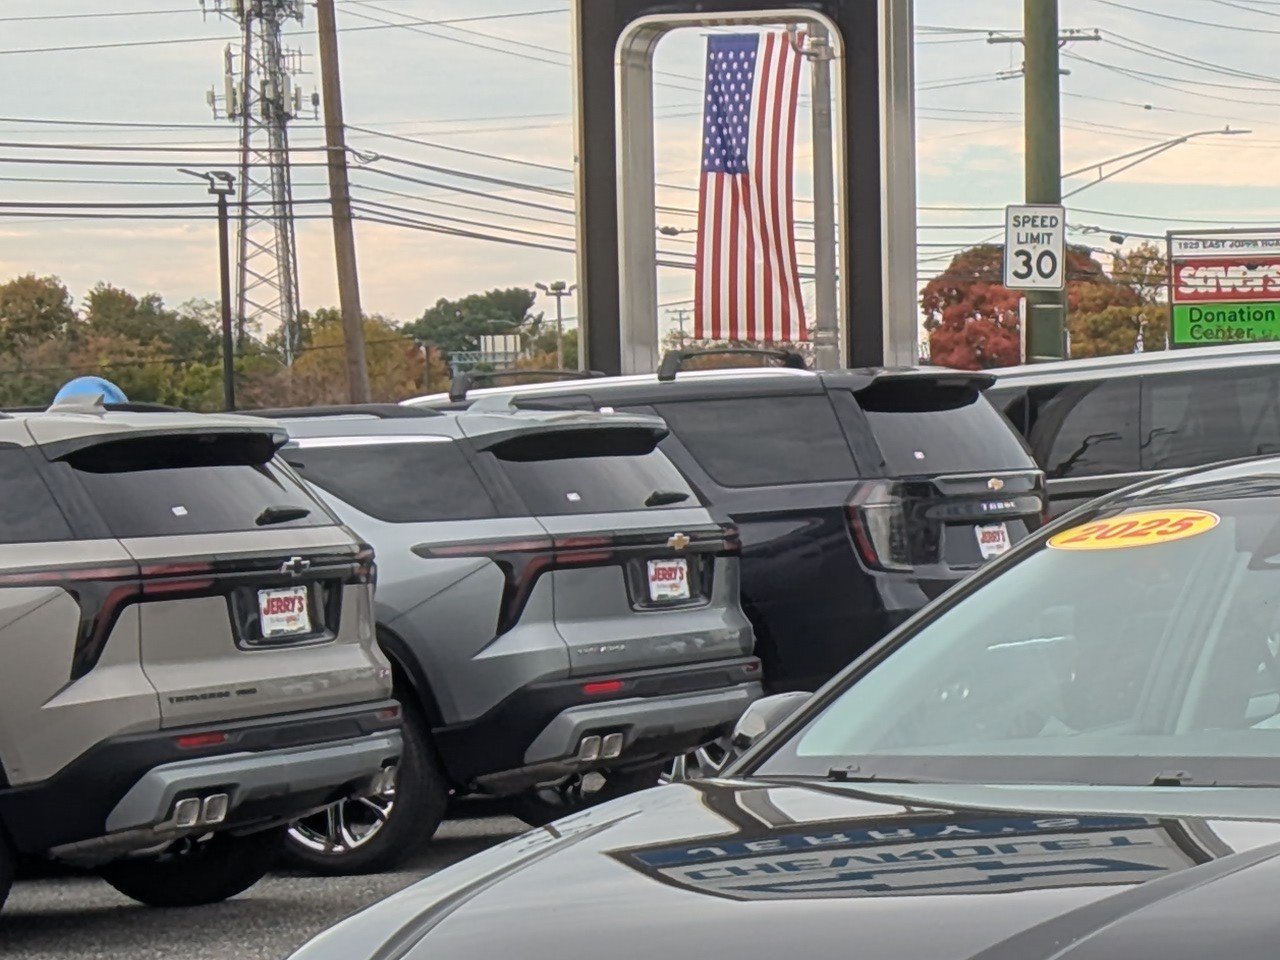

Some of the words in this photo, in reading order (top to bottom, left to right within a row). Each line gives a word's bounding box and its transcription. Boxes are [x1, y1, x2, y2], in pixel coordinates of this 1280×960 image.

[1012, 215, 1059, 228] SPEED
[1016, 232, 1053, 245] LIMIT
[1202, 240, 1226, 249] EAST
[1012, 249, 1058, 280] 30
[1188, 306, 1276, 323] Donation
[1189, 324, 1254, 340] Center
[1060, 515, 1208, 544] 2025
[651, 566, 685, 582] JERRY'S
[262, 595, 304, 616] JERRY'S
